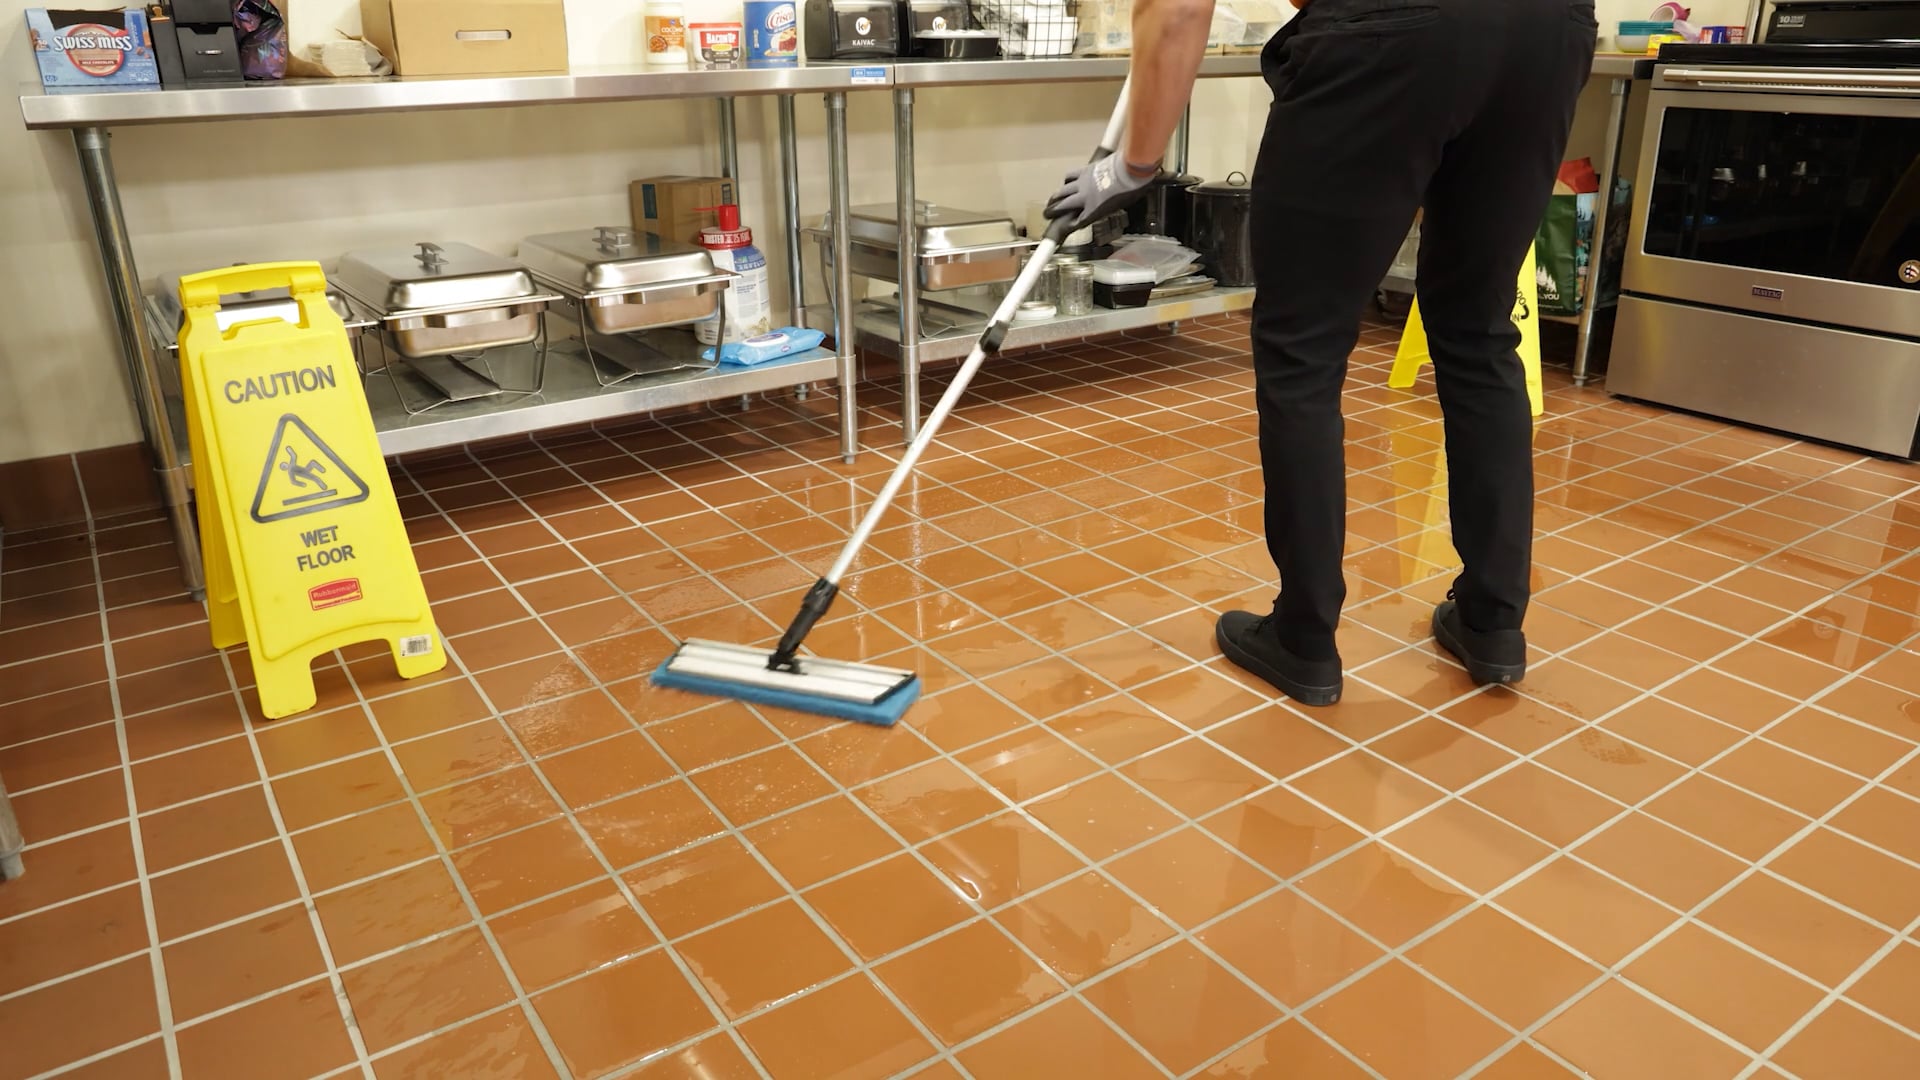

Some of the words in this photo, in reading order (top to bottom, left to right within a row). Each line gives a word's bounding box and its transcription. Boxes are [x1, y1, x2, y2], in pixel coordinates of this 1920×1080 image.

[770, 9, 795, 28] Crisco
[1779, 15, 1790, 23] 10
[53, 35, 95, 52] SWISS
[98, 35, 133, 52] MISS
[224, 365, 337, 404] CAUTION
[300, 525, 339, 548] WET
[296, 544, 356, 572] FLOOR
[313, 582, 356, 599] Rubbermaid
